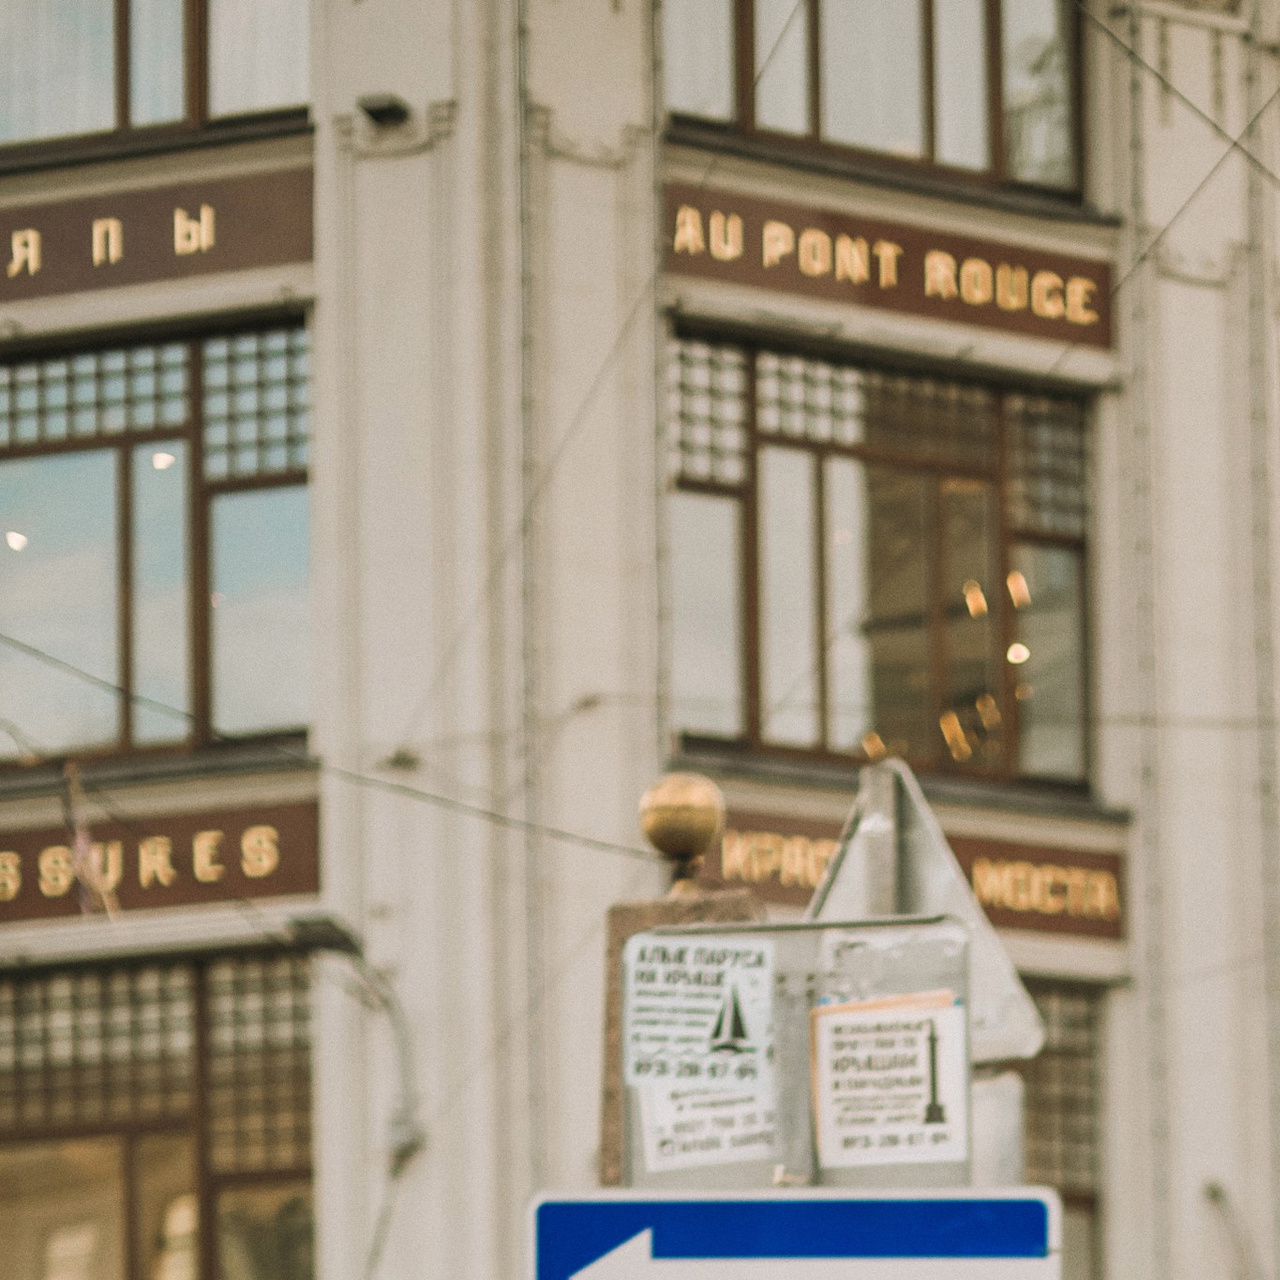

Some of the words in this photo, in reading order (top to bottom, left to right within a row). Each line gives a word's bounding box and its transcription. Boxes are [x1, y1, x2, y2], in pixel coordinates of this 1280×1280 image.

[673, 205, 745, 262] AU
[761, 220, 904, 289] PONT
[923, 249, 1099, 325] ROUGE
